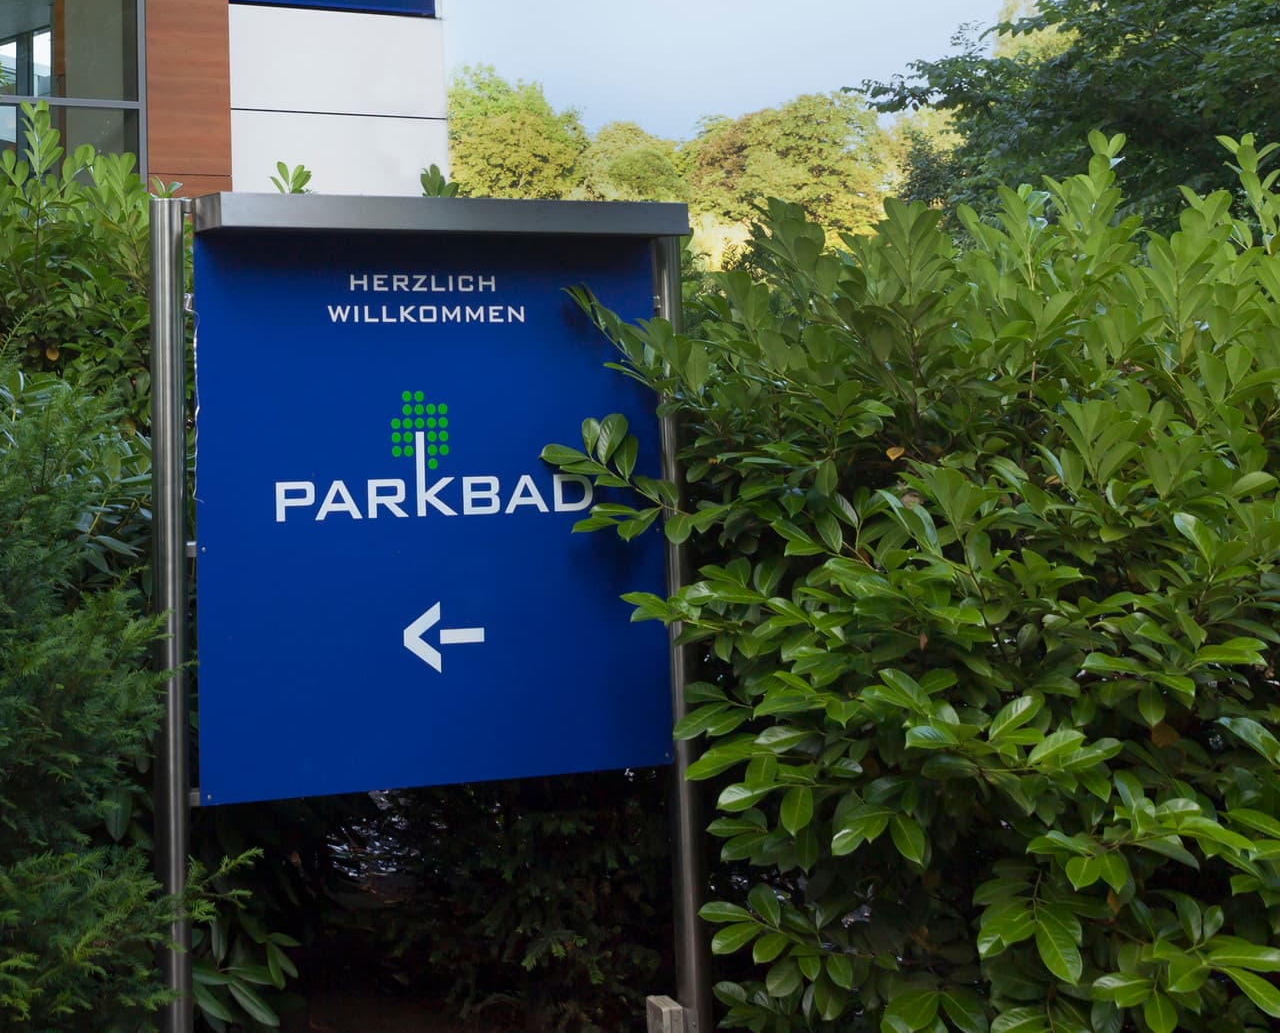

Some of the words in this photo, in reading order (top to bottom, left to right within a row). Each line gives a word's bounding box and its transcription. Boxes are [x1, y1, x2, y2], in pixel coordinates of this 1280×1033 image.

[349, 274, 496, 292] HERZLICH
[327, 304, 526, 323] WILLKOMMEN
[275, 431, 594, 522] PARKBAD
